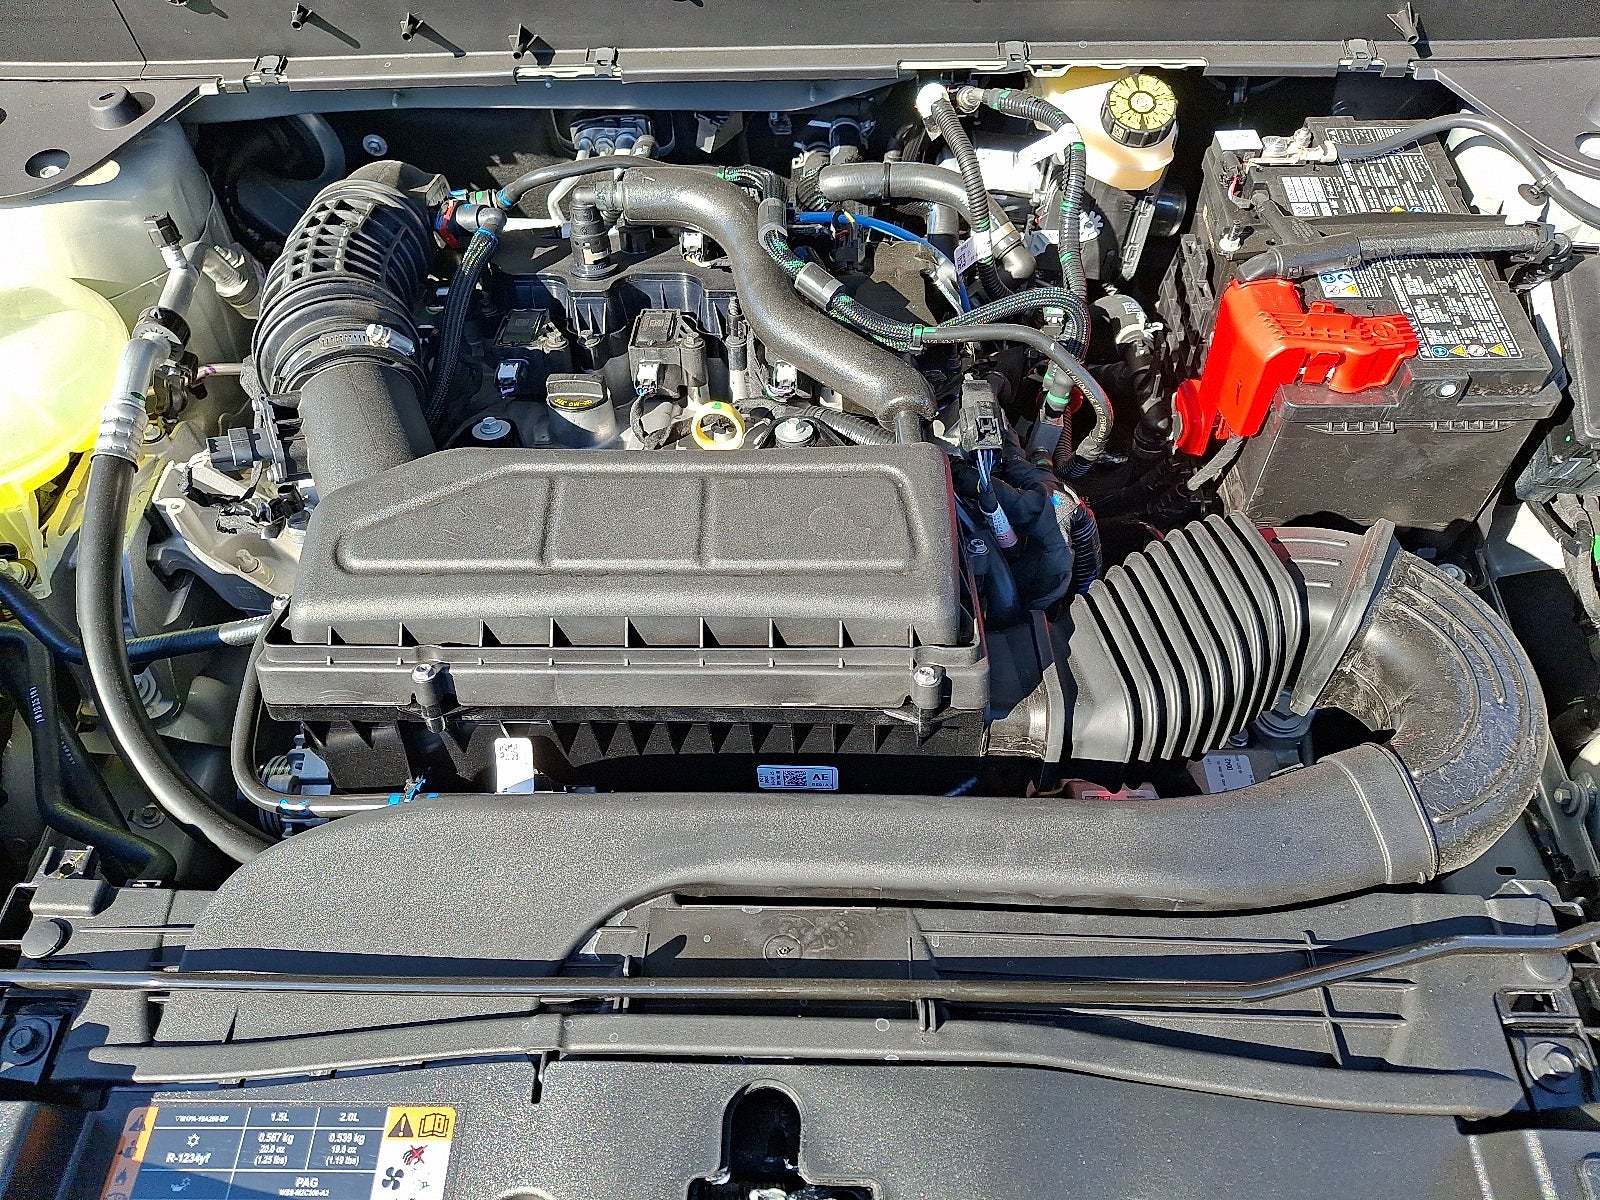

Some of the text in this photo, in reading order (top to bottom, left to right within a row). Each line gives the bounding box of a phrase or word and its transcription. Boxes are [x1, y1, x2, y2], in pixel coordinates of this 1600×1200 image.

[812, 773, 829, 781] AE
[271, 1111, 289, 1121] 1.5L
[339, 1112, 359, 1122] 2.0L
[282, 1132, 295, 1145] kg
[353, 1132, 366, 1145] kg
[275, 1145, 286, 1153] oz
[347, 1145, 357, 1153] oz
[165, 1152, 212, 1166] R-1234yf
[272, 1155, 288, 1166] lbs)
[345, 1156, 359, 1166] lbs)
[295, 1177, 319, 1188] PAG
